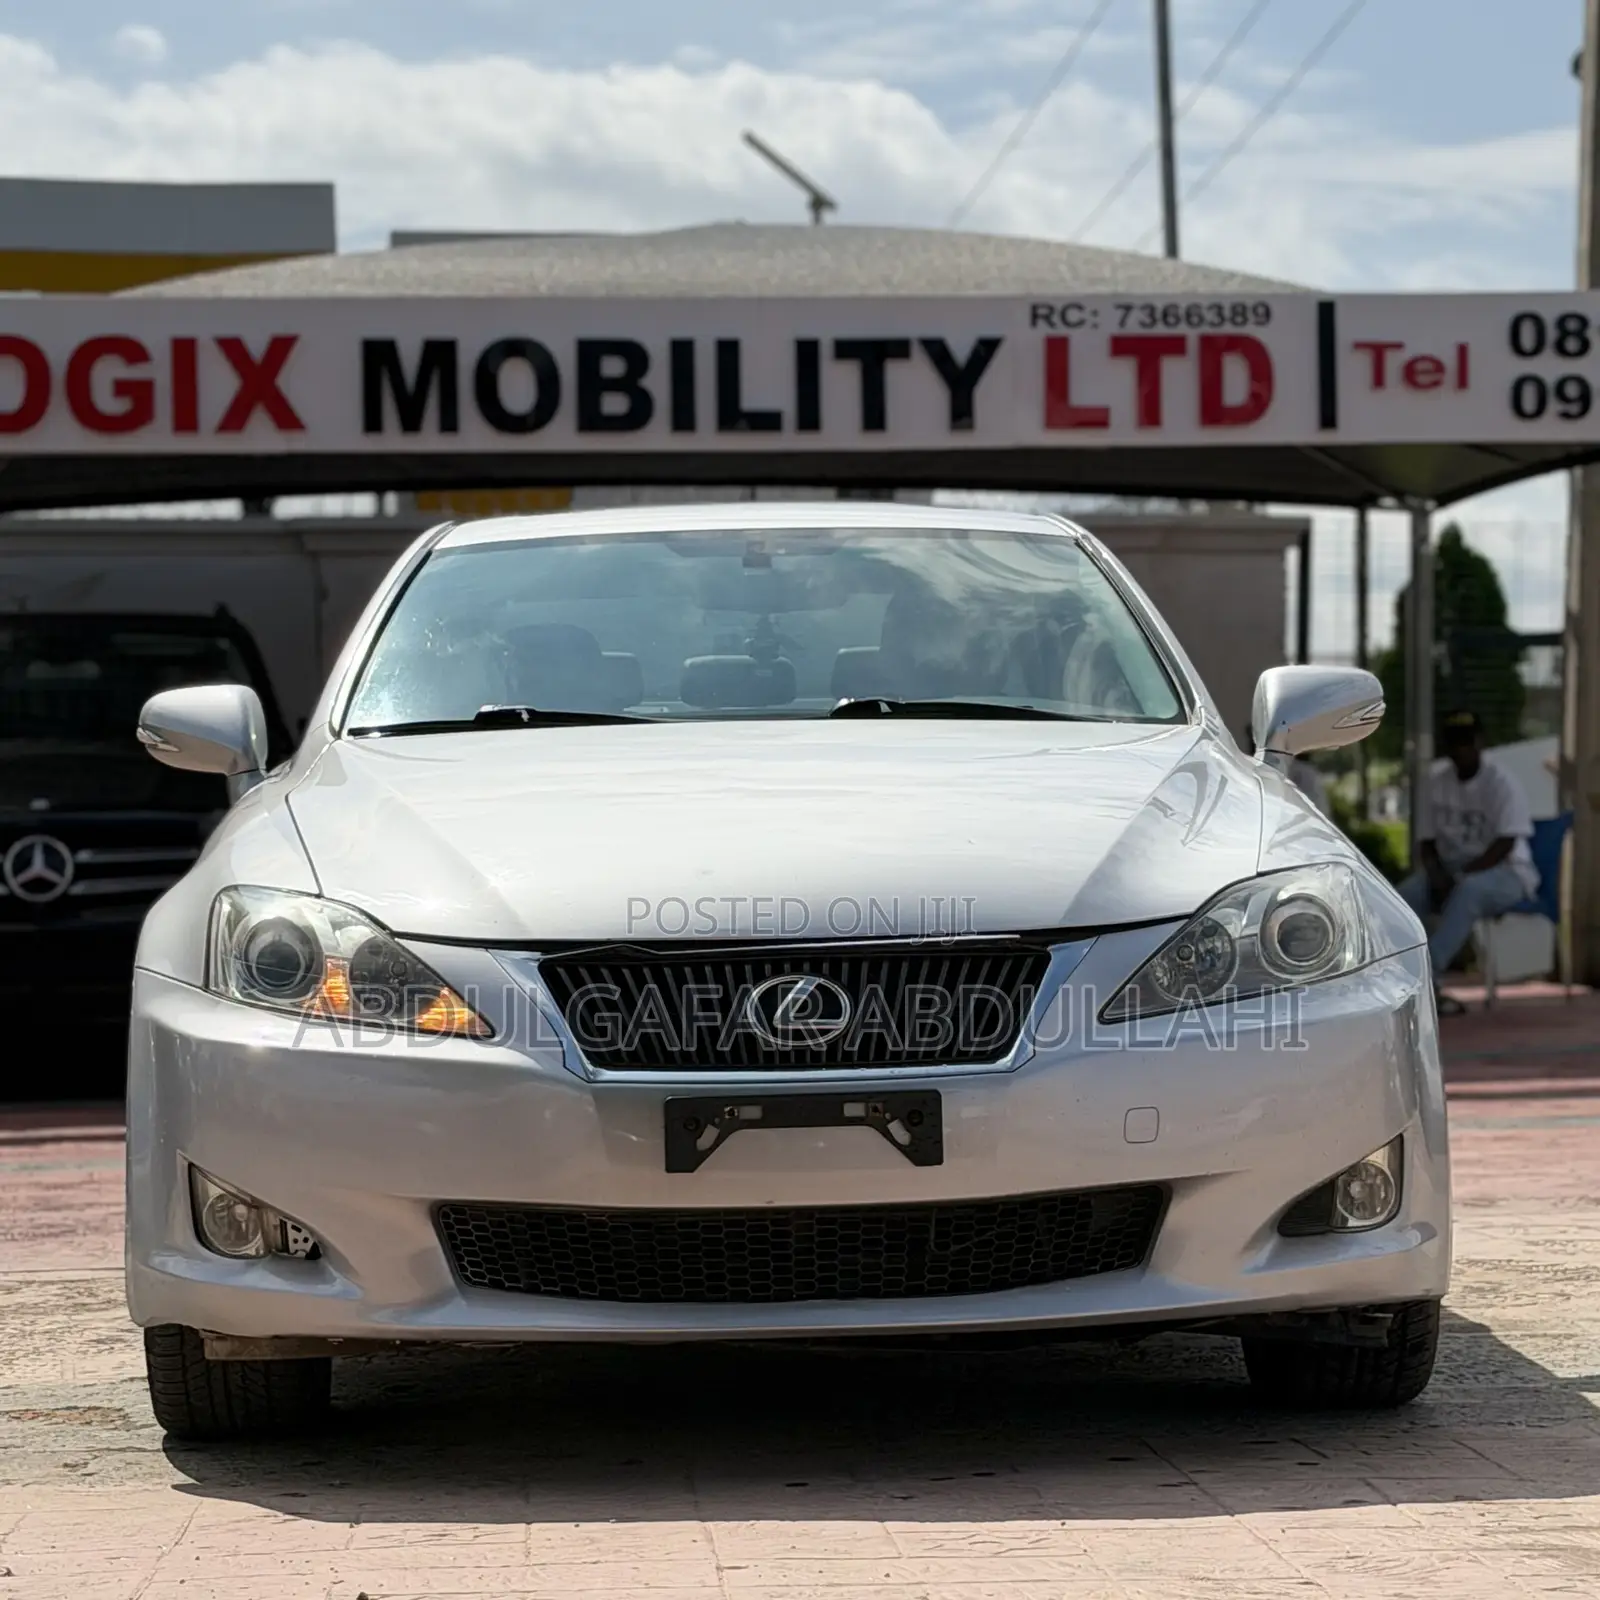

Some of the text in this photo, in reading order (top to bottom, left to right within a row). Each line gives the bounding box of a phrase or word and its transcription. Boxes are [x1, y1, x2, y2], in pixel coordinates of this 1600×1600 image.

[1031, 302, 1271, 329] RC: 7366389
[362, 337, 1003, 434] MOBILITY
[1043, 334, 1275, 430] LTD
[1354, 342, 1469, 390] Tel
